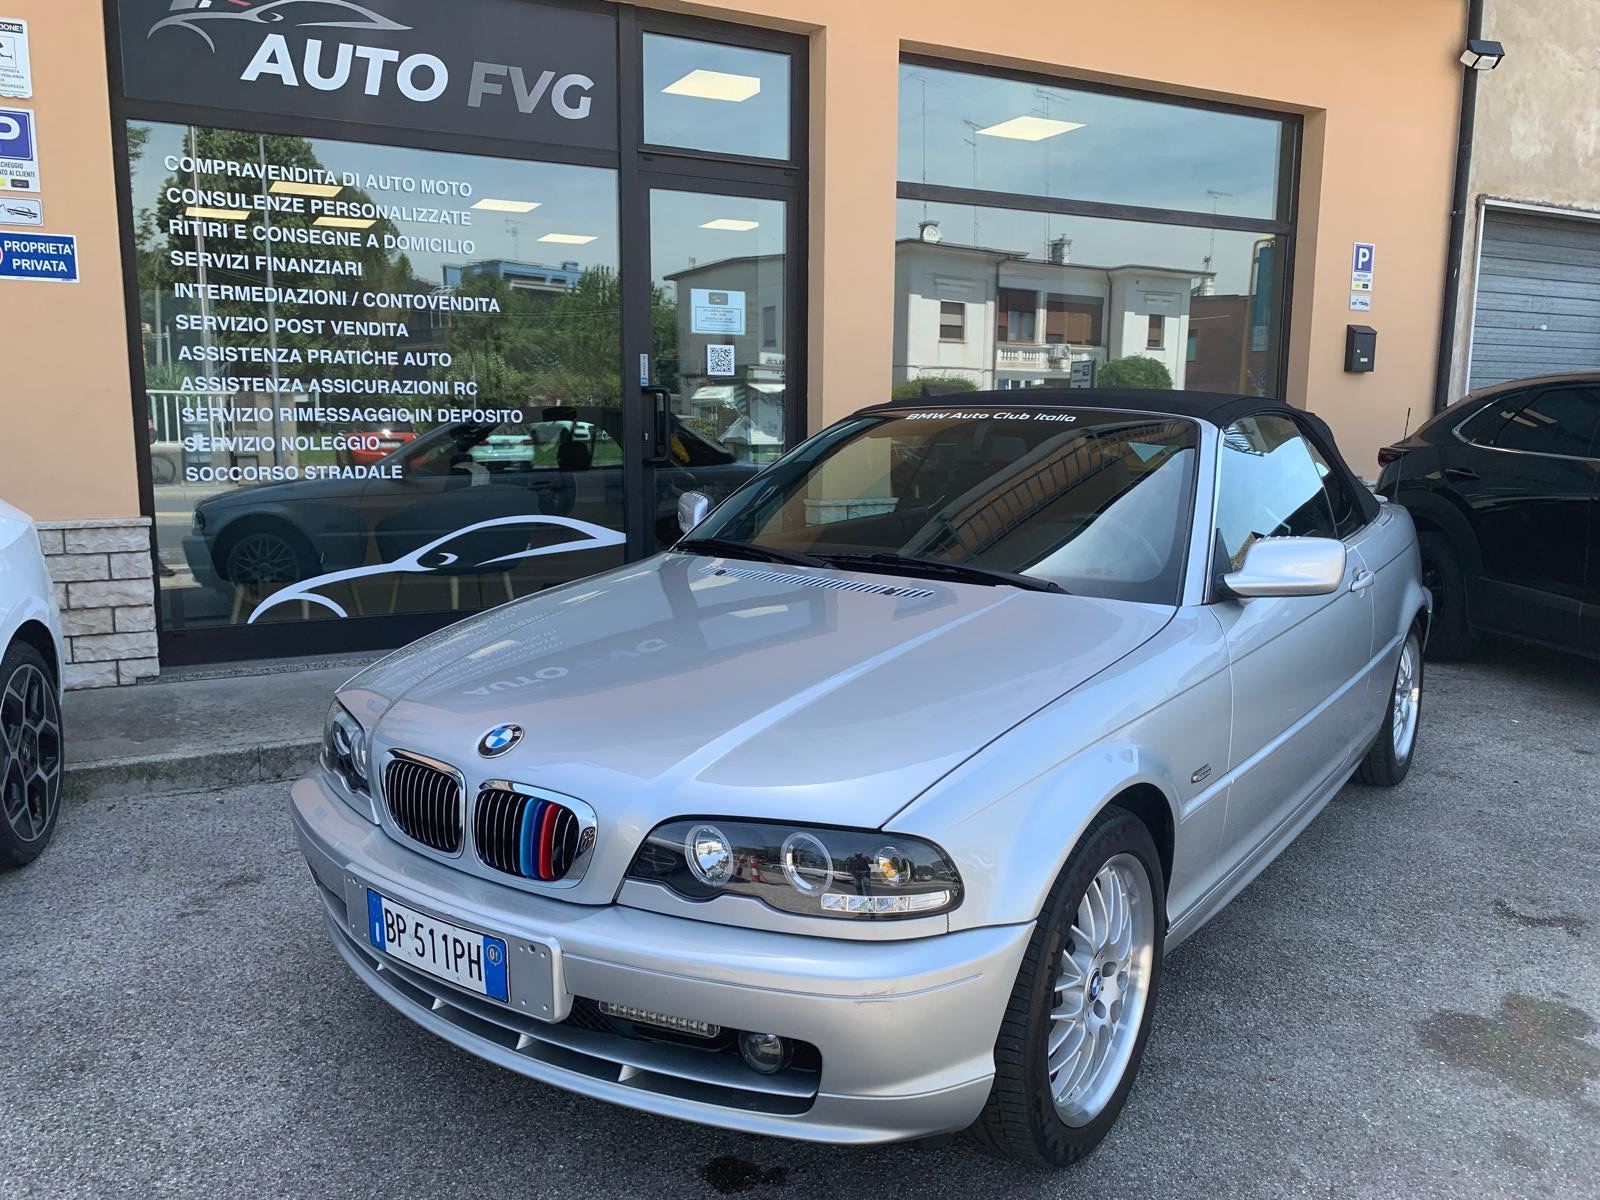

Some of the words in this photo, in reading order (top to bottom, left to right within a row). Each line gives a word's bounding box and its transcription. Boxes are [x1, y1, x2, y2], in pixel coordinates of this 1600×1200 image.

[240, 33, 448, 102] AUTO
[467, 61, 595, 120] FVG
[164, 155, 338, 186] COMPRAVENDITA
[342, 172, 360, 188] DI
[365, 174, 415, 193] AUTO
[421, 178, 472, 198] MOTO
[166, 188, 305, 214] CONSULENZE
[310, 201, 471, 226] PERSONALIZZATE
[4, 240, 74, 255] PROPRIETA'
[169, 220, 228, 238] RITIRI
[235, 224, 247, 240] E
[253, 225, 361, 247] CONSEGNE
[366, 233, 380, 248] A
[384, 235, 475, 255] DOMICILIO
[12, 259, 67, 272] PRIVATA
[170, 251, 250, 270] SERVIZI
[256, 256, 362, 276] FINANZIARI
[1358, 248, 1369, 269] P
[174, 282, 347, 306] INTERMEDIAZIONI
[351, 291, 358, 306] /
[363, 292, 500, 313] CONTOVENDITA
[175, 314, 270, 333] SERVIZIO
[275, 319, 323, 335] POST
[331, 321, 409, 337] VENDITA
[178, 346, 300, 363] ASSISTENZA
[307, 350, 398, 366] PRATICHE
[403, 352, 452, 367] AUTO
[180, 377, 304, 393] ASSISTENZA
[308, 380, 449, 395] ASSICURAZIONI
[454, 381, 478, 395] RC
[182, 407, 274, 423] SERVIZIO
[279, 407, 410, 423] RIMESSAGGIO
[415, 409, 434, 423] IN
[441, 409, 523, 424] DEPOSITO
[993, 412, 1030, 420] Club
[1034, 413, 1077, 422] Italia
[183, 436, 275, 452] SERVIZIO
[281, 436, 381, 452] NOLEGGIO
[185, 466, 299, 481] SOCCORSO
[304, 465, 403, 480] STRADALE
[384, 908, 406, 947] BP
[414, 922, 482, 981] 511PH
